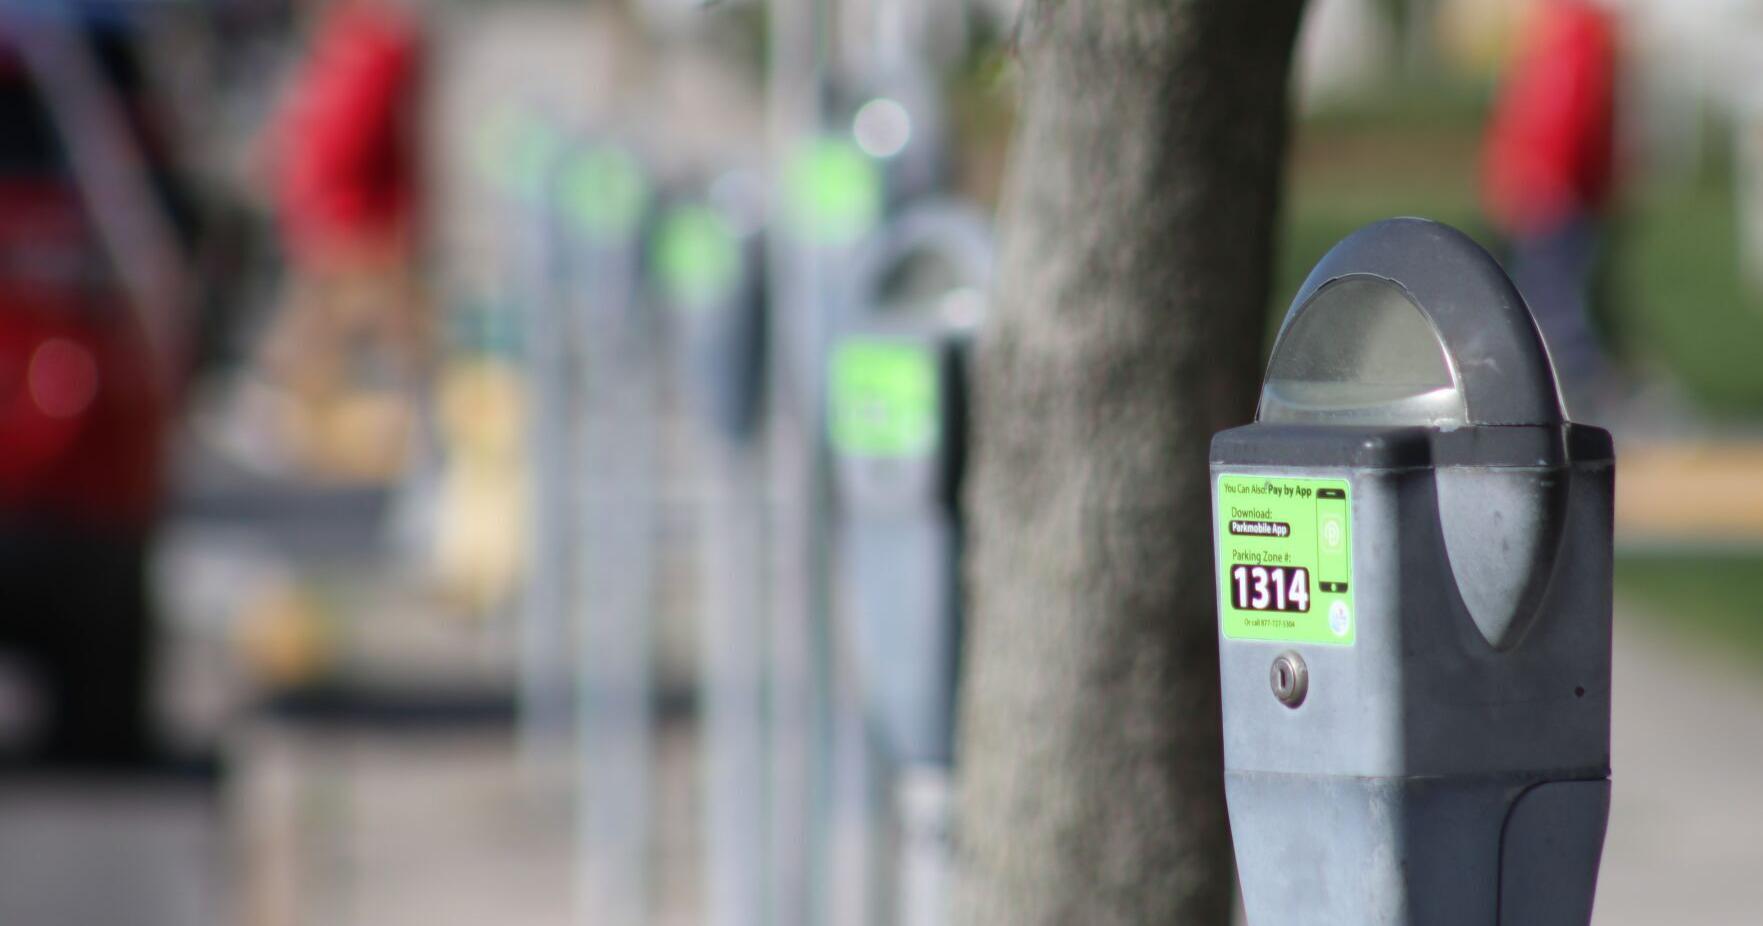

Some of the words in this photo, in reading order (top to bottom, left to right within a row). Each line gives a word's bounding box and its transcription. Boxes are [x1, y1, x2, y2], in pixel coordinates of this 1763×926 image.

[1224, 483, 1236, 493] You
[1237, 484, 1249, 494] Can
[1268, 484, 1282, 497] Pay
[1284, 484, 1294, 497] by
[1296, 486, 1312, 498] App
[1231, 506, 1272, 519] Download:
[1232, 522, 1271, 534] Parkmobile
[1272, 524, 1287, 536] App
[1232, 549, 1261, 564] Parking
[1263, 551, 1282, 562] Zone
[1284, 553, 1291, 563] #:
[1234, 566, 1308, 611] 1314
